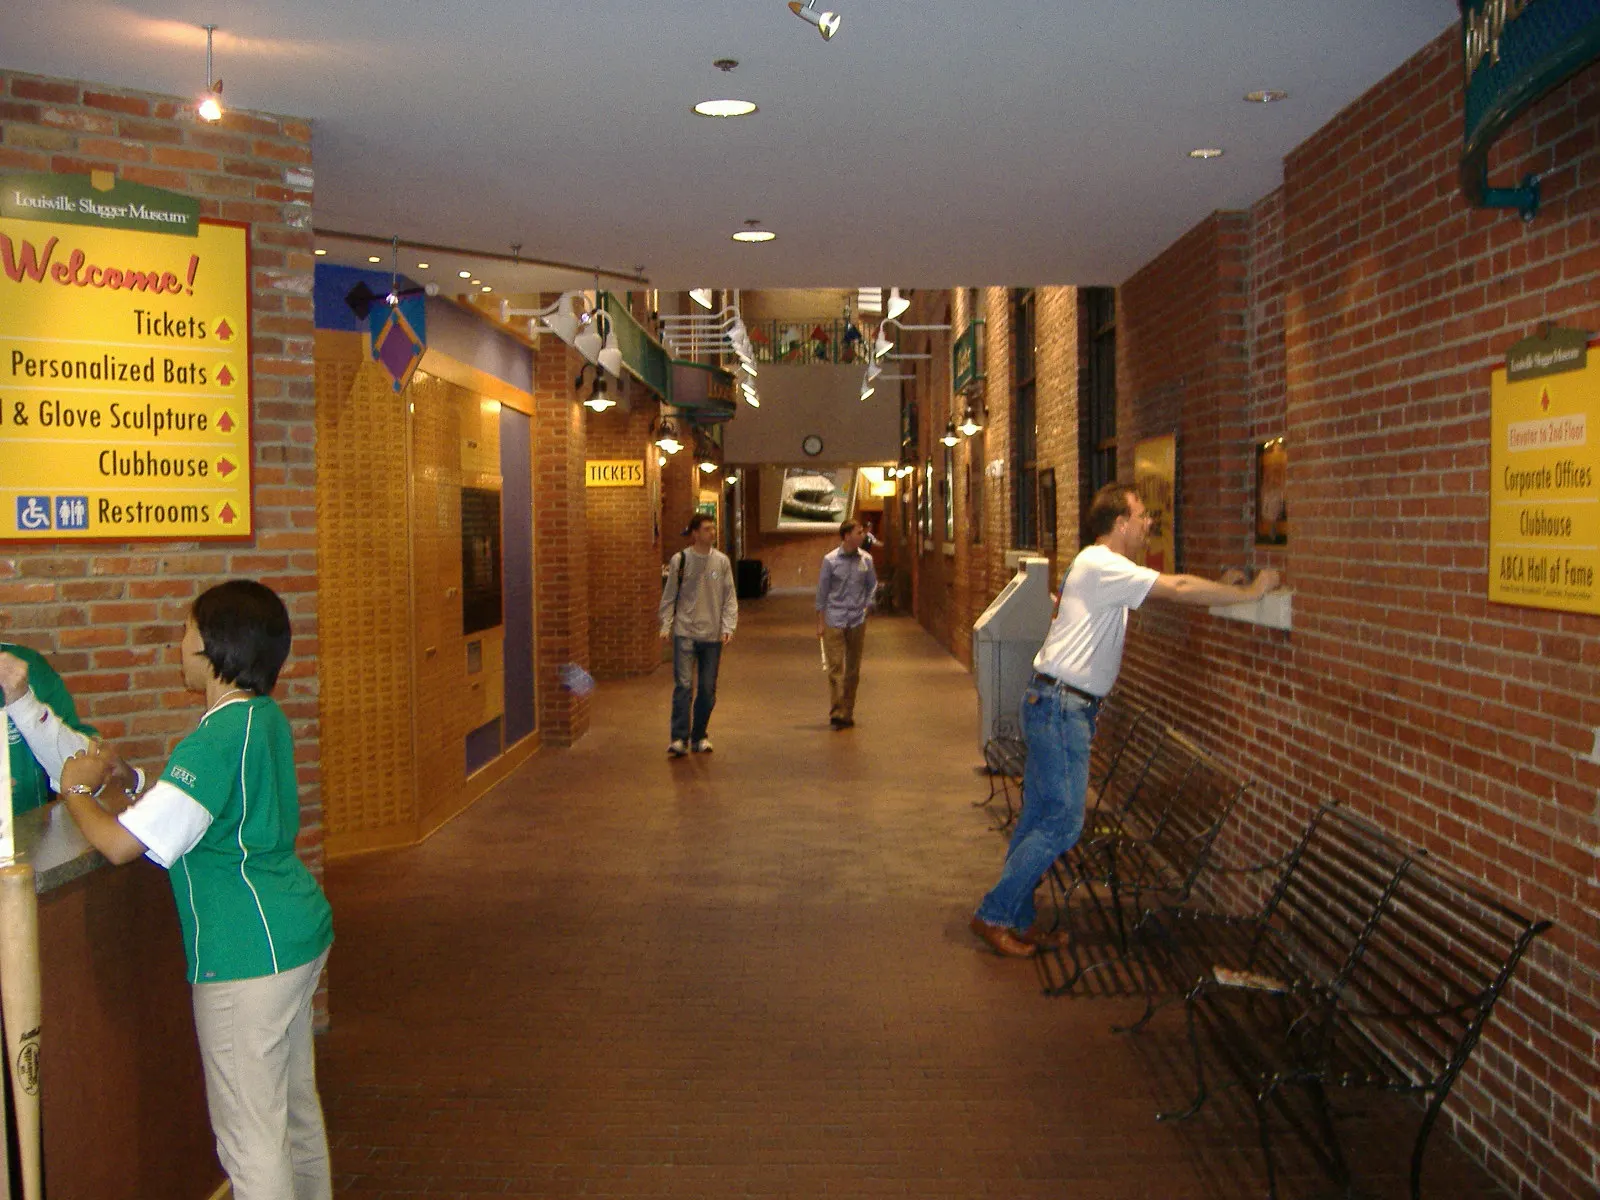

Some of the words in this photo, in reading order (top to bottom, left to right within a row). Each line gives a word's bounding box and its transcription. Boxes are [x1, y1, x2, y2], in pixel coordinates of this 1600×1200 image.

[14, 191, 77, 212] Louisville
[79, 198, 128, 219] Slugger
[129, 203, 187, 223] Museum
[0, 232, 200, 296] Welcome!
[134, 310, 207, 339] Tickets
[12, 351, 155, 383] Personalized
[164, 359, 208, 385] Bats
[13, 401, 29, 426] &
[39, 400, 101, 427] Glove
[110, 403, 208, 436] Sculpture
[99, 450, 208, 477] Clubhouse
[590, 464, 641, 481] TICKETS
[1504, 466, 1551, 496] Corporate
[1555, 460, 1592, 488] Offices
[99, 499, 210, 524] Restrooms
[1520, 509, 1572, 537] Clubhouse
[1500, 554, 1524, 582] ABCA
[1527, 557, 1548, 584] Hall
[1549, 557, 1561, 585] of
[1564, 557, 1594, 588] Fame
